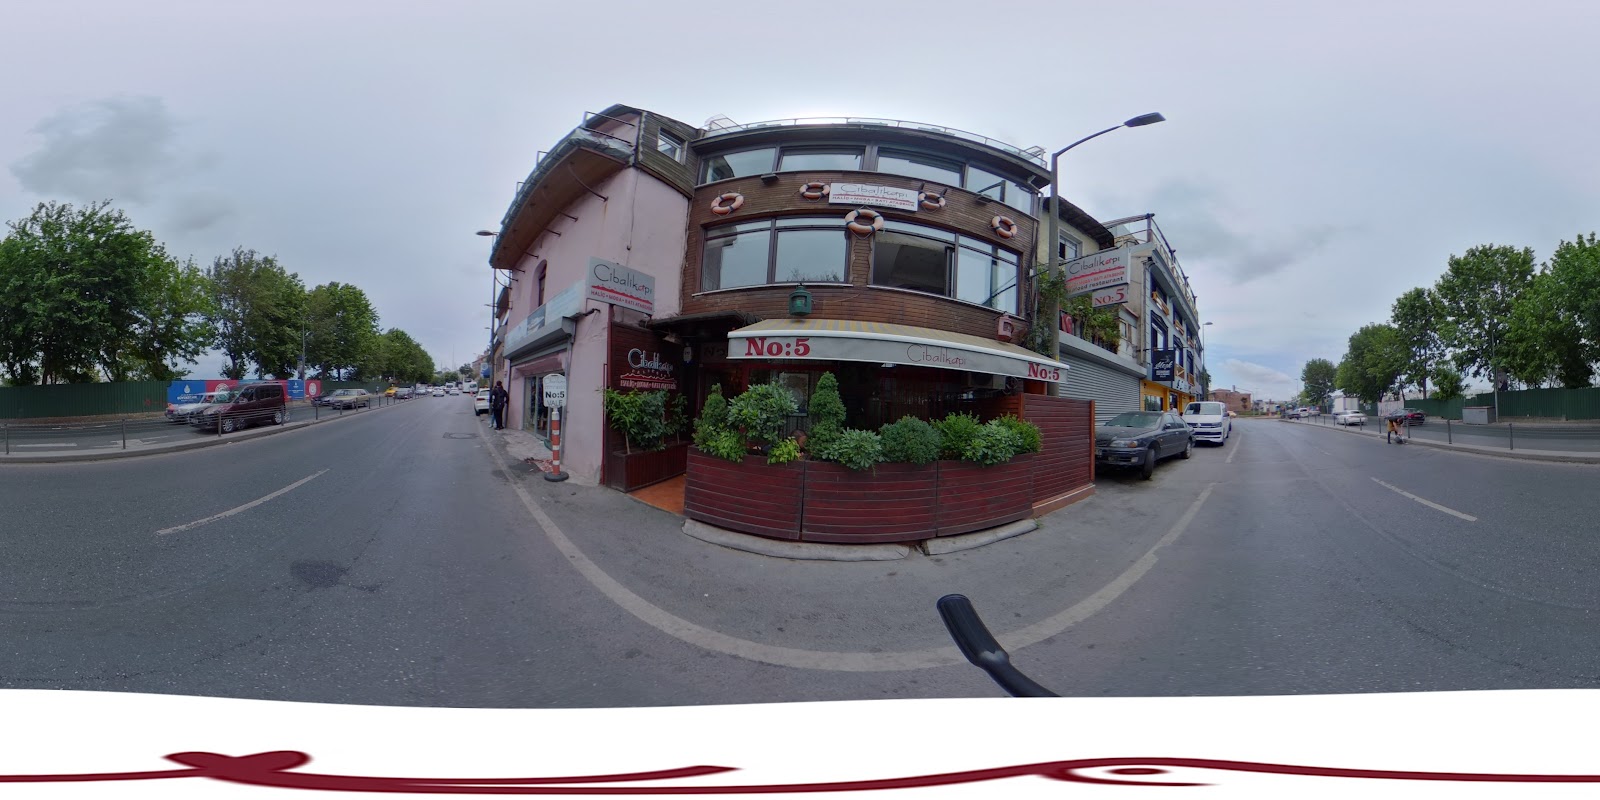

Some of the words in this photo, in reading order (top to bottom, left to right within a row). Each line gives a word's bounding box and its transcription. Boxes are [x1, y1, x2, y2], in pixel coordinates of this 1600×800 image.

[1089, 276, 1124, 288] restaurant
[745, 337, 811, 357] No:5
[1027, 360, 1060, 381] No:5
[545, 390, 565, 399] No:5
